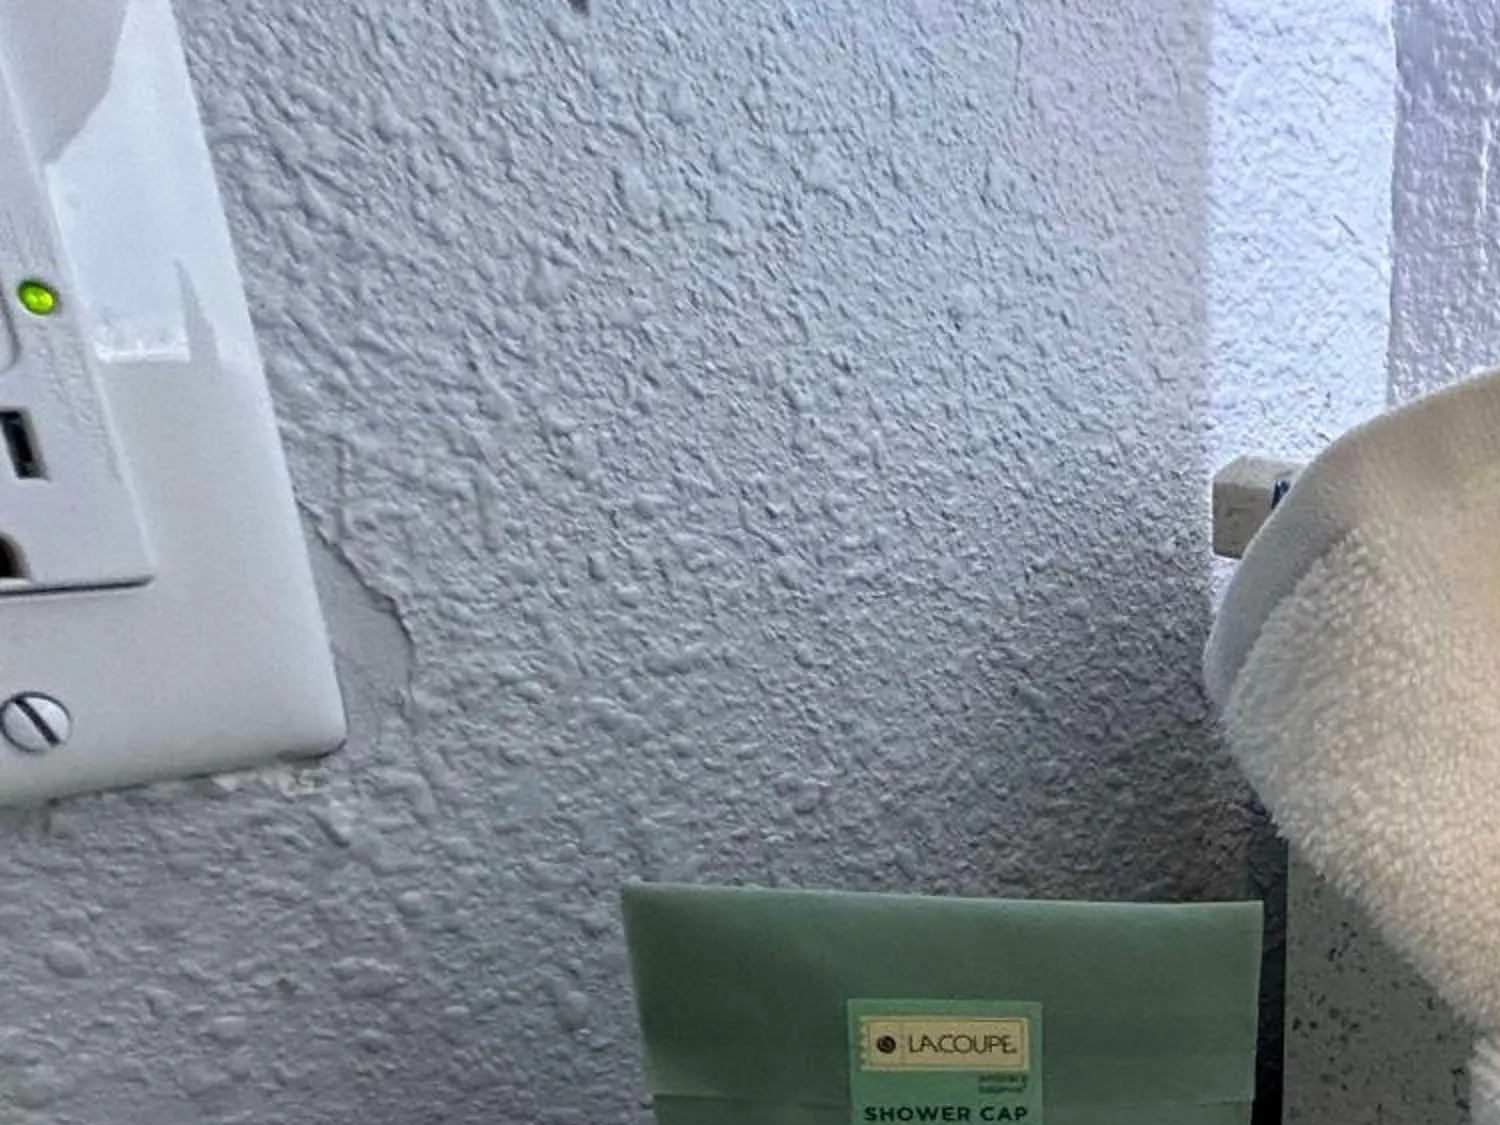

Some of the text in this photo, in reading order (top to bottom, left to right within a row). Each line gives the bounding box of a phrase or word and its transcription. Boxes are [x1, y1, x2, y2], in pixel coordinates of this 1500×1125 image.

[908, 1035, 1016, 1054] LACOUPE
[864, 1106, 1029, 1122] SHOWER CAP
